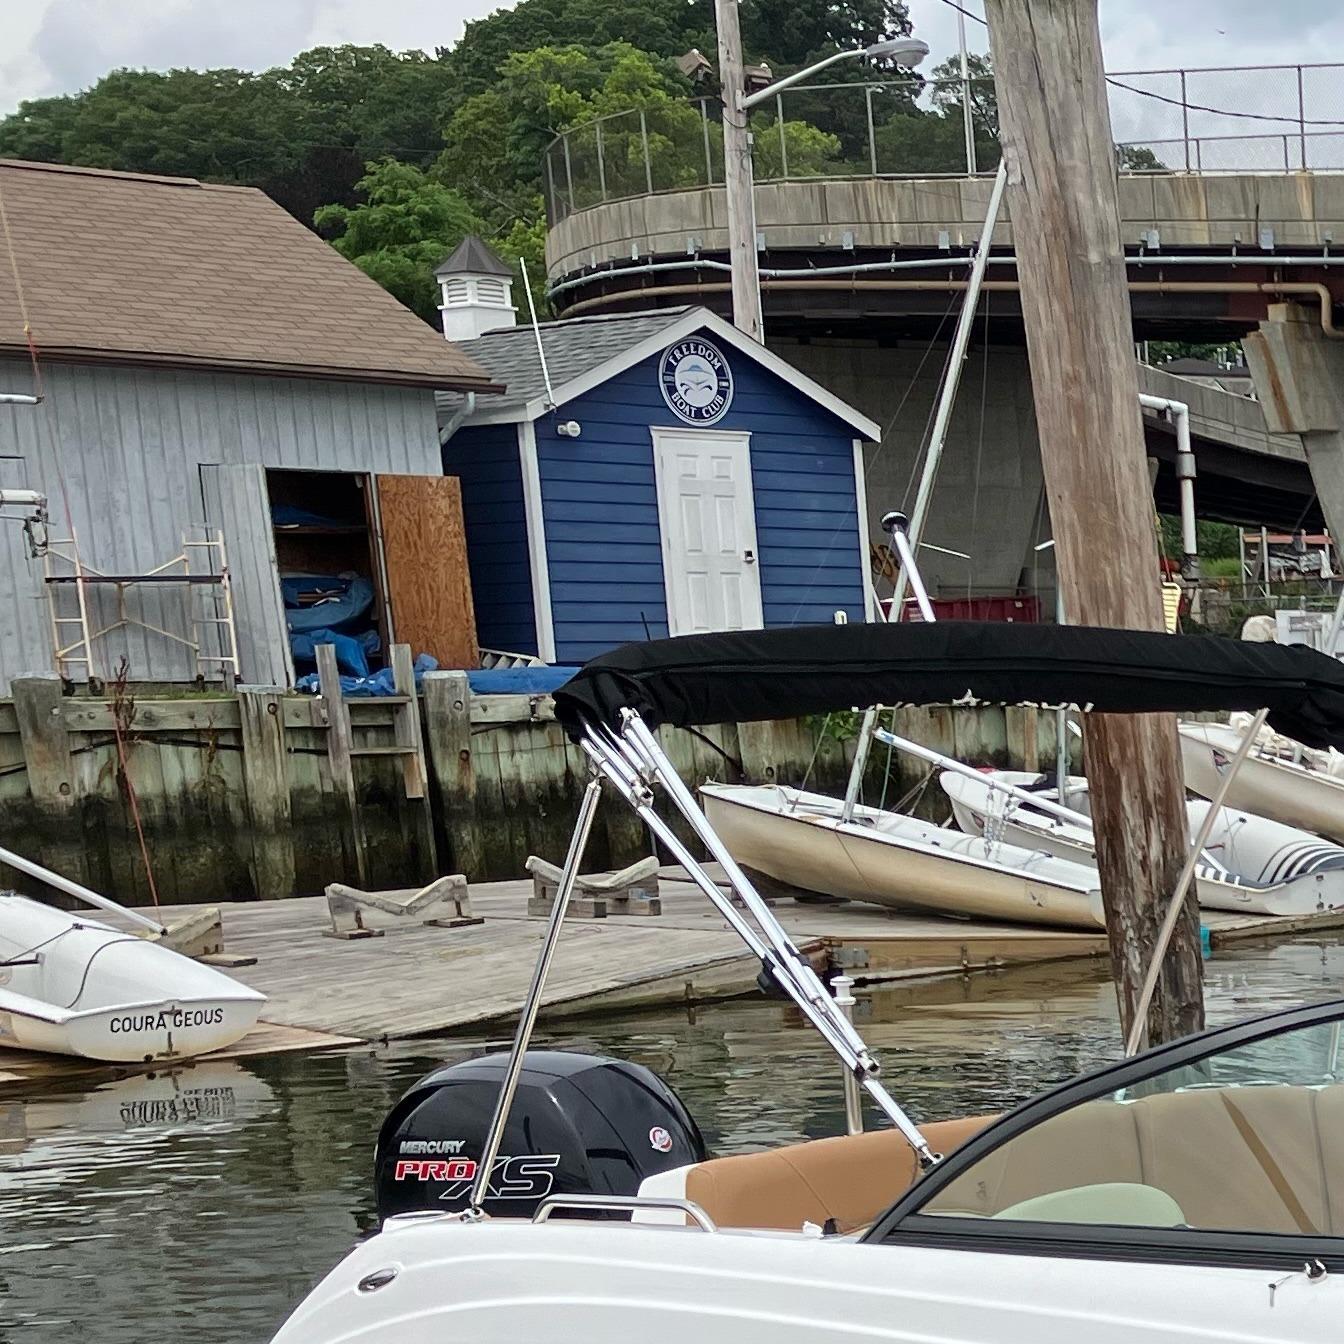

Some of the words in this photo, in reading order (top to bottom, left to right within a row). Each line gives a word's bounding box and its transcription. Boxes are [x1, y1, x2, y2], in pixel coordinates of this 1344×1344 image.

[668, 343, 722, 370] FREEDOM
[671, 391, 698, 418] BOAT
[701, 394, 725, 418] CLUB
[400, 1140, 466, 1154] MERCURY
[395, 1160, 477, 1181] PRO
